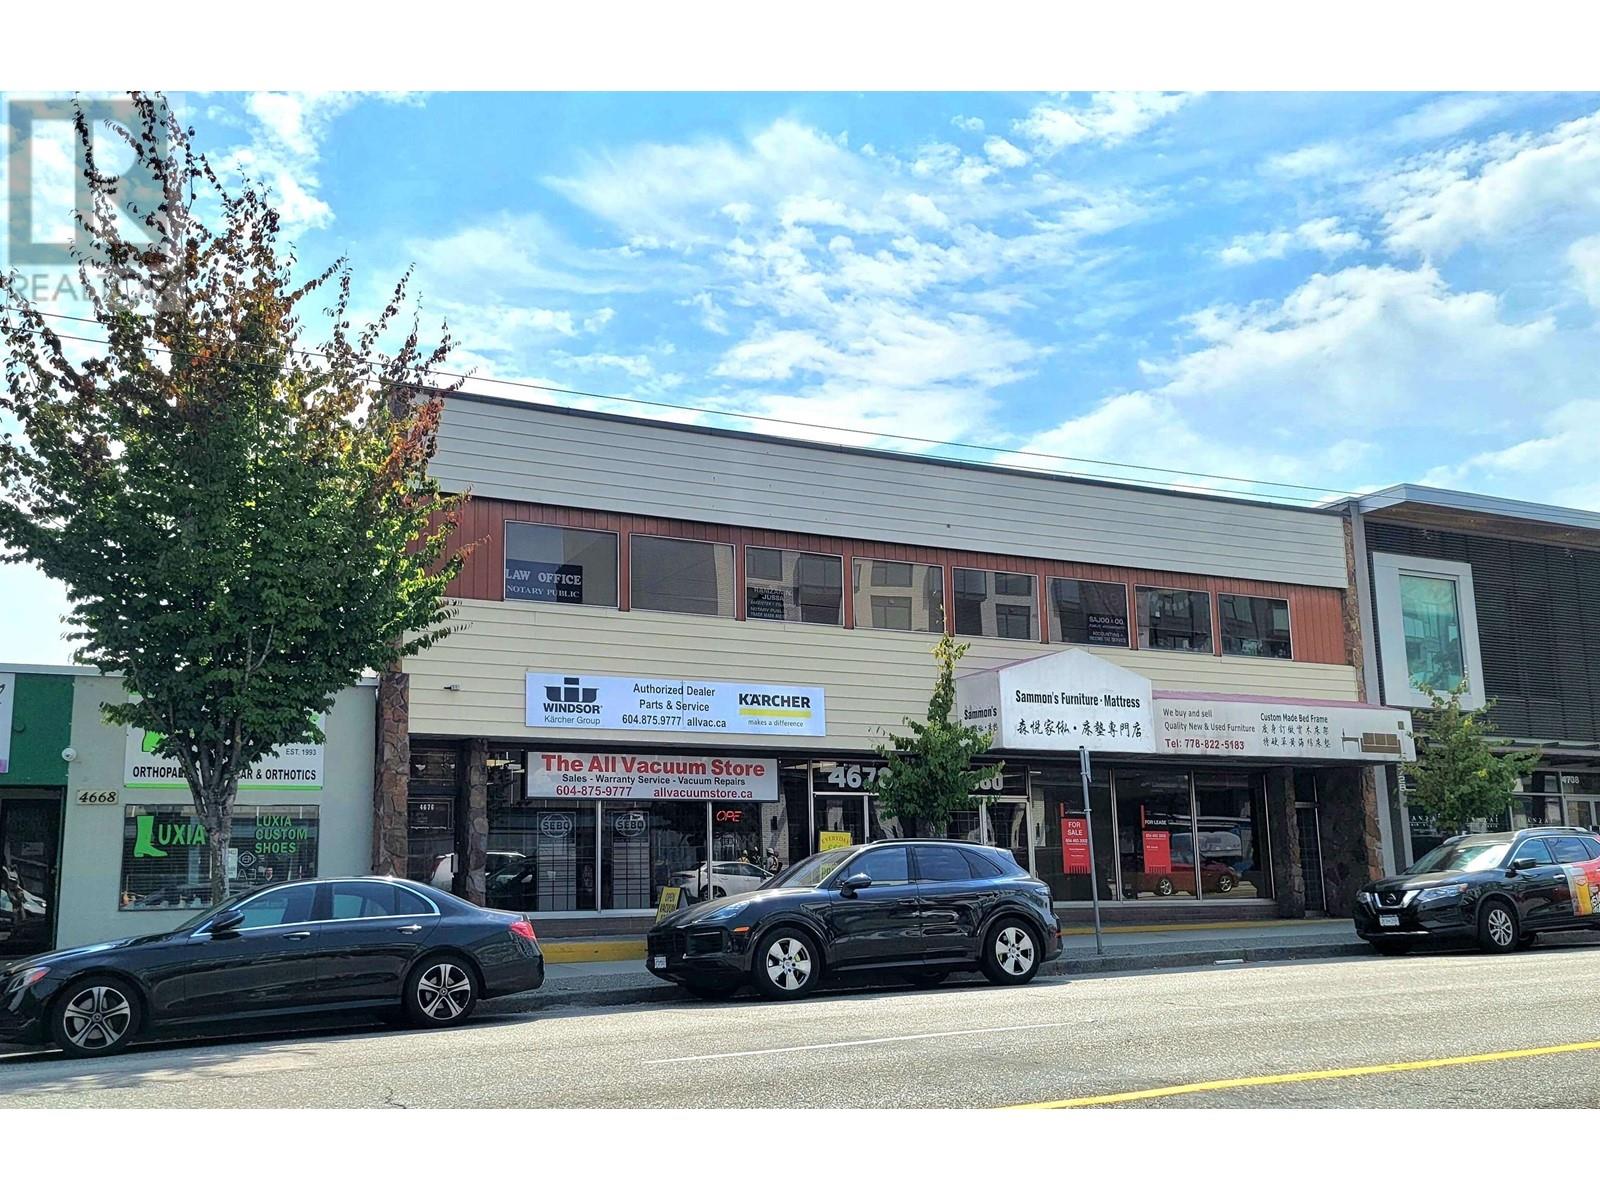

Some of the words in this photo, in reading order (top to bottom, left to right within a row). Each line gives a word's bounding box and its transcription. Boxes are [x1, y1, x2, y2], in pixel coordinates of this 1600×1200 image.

[506, 568, 531, 581] LAW
[537, 572, 582, 585] OFFICE
[507, 585, 544, 595] NOTARY
[546, 589, 580, 598] PUBLIC
[632, 683, 684, 695] Authorized
[686, 686, 716, 697] Dealer
[639, 699, 664, 710] Parts
[666, 700, 673, 710] &
[675, 701, 710, 712] Service
[738, 693, 812, 708] KÄRCHER
[1015, 690, 1059, 705] Sammon's
[1061, 692, 1098, 706] Furniture
[1104, 694, 1140, 708] Mattress
[543, 703, 600, 714] WINDSOR
[963, 706, 997, 720] Sammon's
[1163, 708, 1174, 717] We
[1174, 709, 1187, 718] buy
[1188, 710, 1200, 718] and
[1201, 710, 1213, 718] sell
[544, 715, 576, 724] Kärcher
[576, 716, 601, 726] Group
[622, 714, 682, 726] 604.875.9777
[687, 717, 727, 728] allvac.ca
[748, 719, 768, 727] makes
[773, 720, 804, 728] difference
[1260, 712, 1281, 722] Custom
[1282, 714, 1298, 722] Made
[1298, 714, 1310, 723] Bed
[1310, 714, 1328, 724] Frame
[1164, 721, 1188, 732] Quality
[1188, 722, 1203, 731] New
[1204, 723, 1210, 731] &
[1210, 723, 1227, 732] Used
[1227, 723, 1256, 733] Furniture
[1165, 738, 1182, 749] Tel:
[1184, 739, 1245, 751] 778-822-5183
[286, 748, 300, 757] EST.
[302, 749, 317, 757] 1993
[541, 755, 585, 772] The
[587, 755, 617, 773] All
[620, 756, 707, 776] Vacuum
[710, 758, 766, 777] Store
[256, 768, 262, 780] &
[265, 769, 317, 781] ORTHOTICS
[562, 773, 588, 784] Sales
[595, 774, 636, 786] Warranty
[637, 776, 671, 786] Service
[677, 776, 713, 786] Vacuum
[714, 777, 746, 787] Repairs
[79, 791, 117, 803] 4668
[556, 785, 633, 798] 604-875-9777
[653, 787, 753, 799] allvacuumstore.ca
[256, 815, 292, 827] LUXIA
[542, 821, 571, 831] SEBO
[616, 820, 646, 830] SEBO
[1068, 821, 1081, 829] FOR
[255, 828, 308, 841] CUSTOM
[255, 842, 297, 854] SHOES
